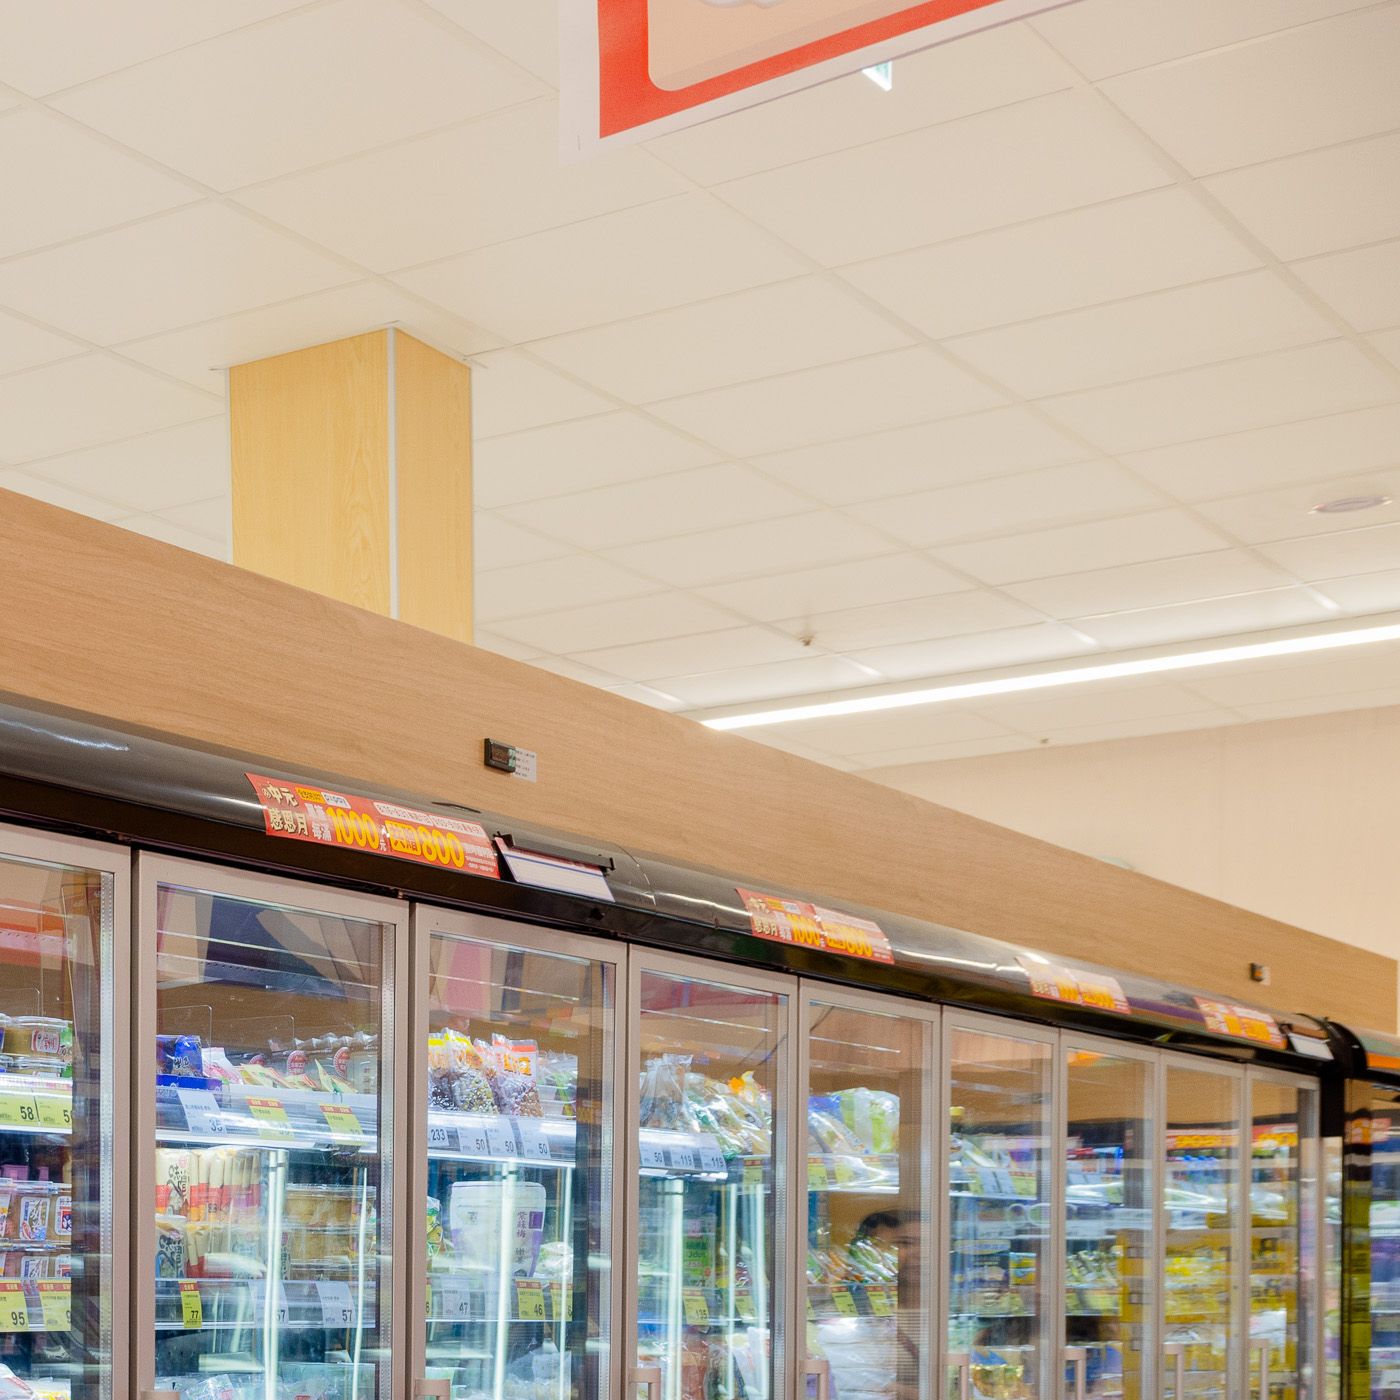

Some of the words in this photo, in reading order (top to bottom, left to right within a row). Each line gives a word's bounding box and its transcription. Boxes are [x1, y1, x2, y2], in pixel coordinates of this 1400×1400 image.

[326, 807, 379, 850] 1000
[418, 826, 465, 868] 800
[19, 1105, 34, 1121] 58
[430, 1128, 447, 1142] 233
[10, 1311, 25, 1327] 95
[341, 1309, 354, 1323] 57
